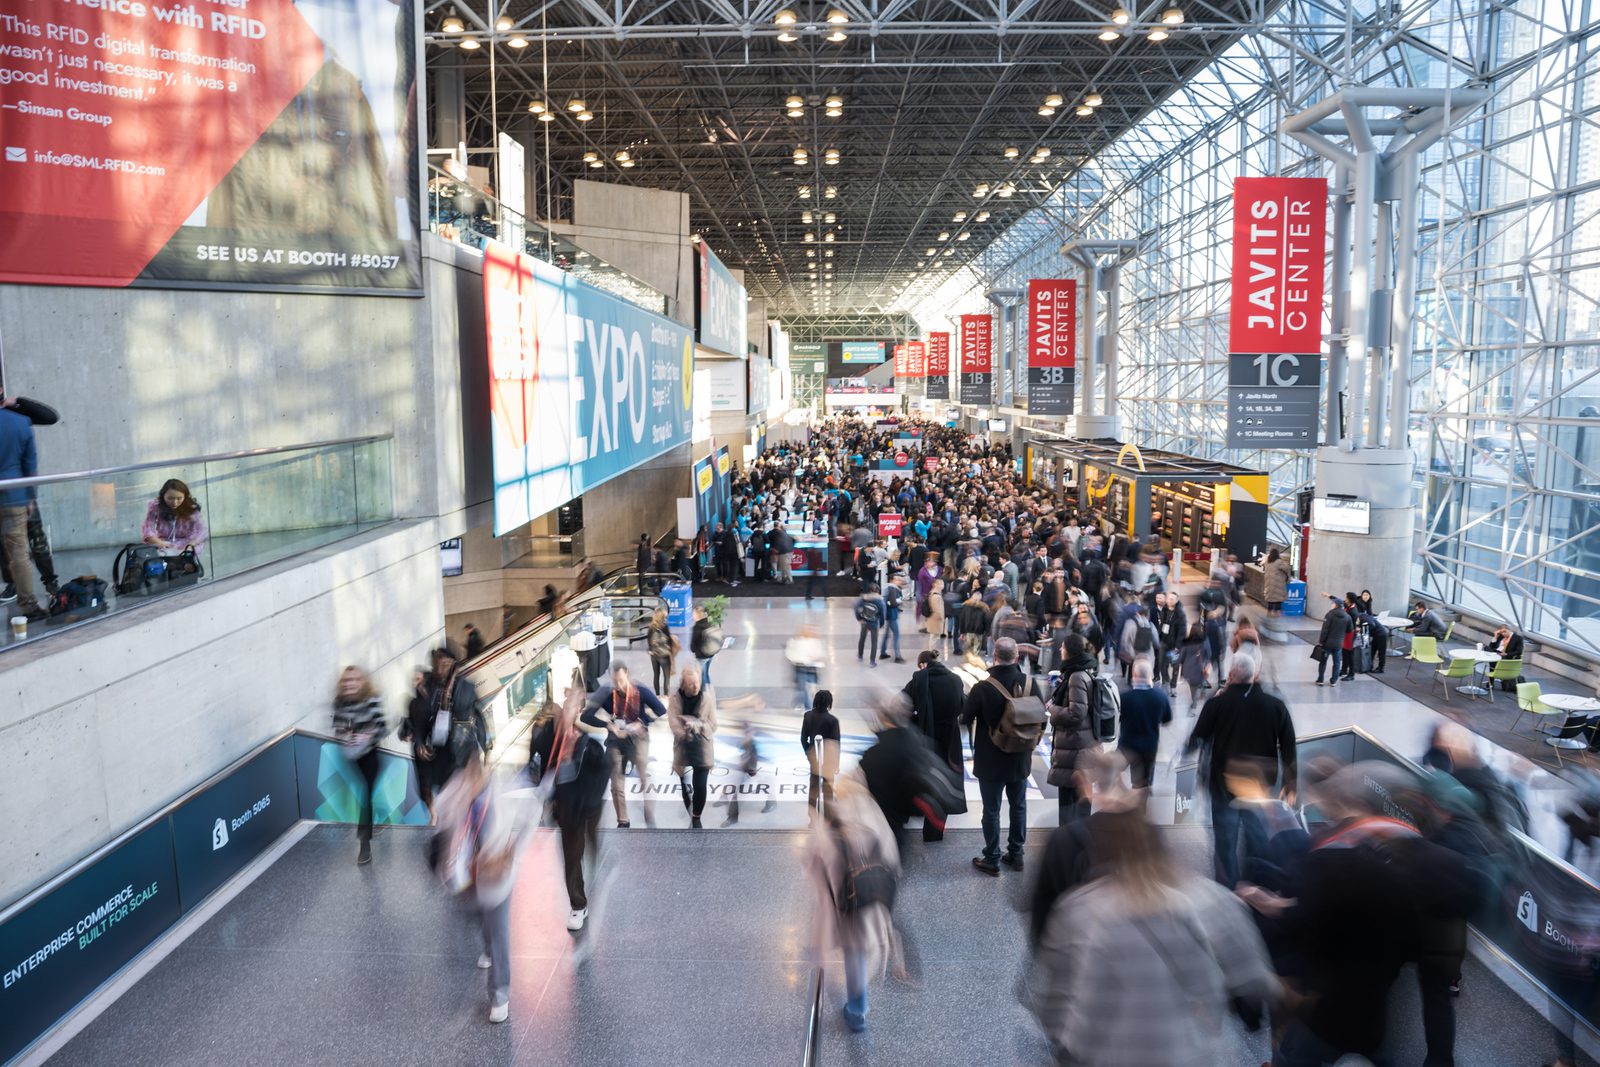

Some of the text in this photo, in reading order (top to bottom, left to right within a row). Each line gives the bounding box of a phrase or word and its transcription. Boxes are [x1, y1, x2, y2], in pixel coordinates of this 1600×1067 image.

[152, 4, 203, 29] with
[211, 11, 267, 40] RFID
[46, 23, 88, 45] RFID
[94, 32, 144, 56] digital
[150, 44, 256, 74] transformation
[0, 68, 48, 86] good
[58, 49, 88, 69] just
[93, 59, 177, 86] necessary,
[182, 70, 192, 85] it
[195, 76, 224, 91] was
[227, 81, 238, 93] a
[67, 108, 113, 127] Group
[34, 150, 165, 176] info@SML-RFID.com
[197, 245, 399, 269] SEE US AT BOOTH #5057
[1248, 200, 1278, 329] JAVITS
[1287, 200, 1311, 331] CENTER
[1036, 290, 1051, 356] JAVITS
[1056, 290, 1068, 356] CENTER
[908, 346, 916, 373] JAVITS
[930, 337, 938, 370] JAVITS
[965, 321, 976, 366] JAVITS
[979, 321, 987, 366] CENTER
[932, 375, 945, 385] 3A
[968, 372, 984, 385] 1B
[1040, 367, 1064, 385] 3B
[1253, 354, 1300, 387] 1C
[566, 314, 647, 466] EXPO
[708, 783, 770, 795] YOUR
[231, 794, 271, 831] Booth 5065
[79, 881, 158, 950] BUILT FOR SCALE
[3, 884, 133, 989] ENTERPRISE COMMERCE
